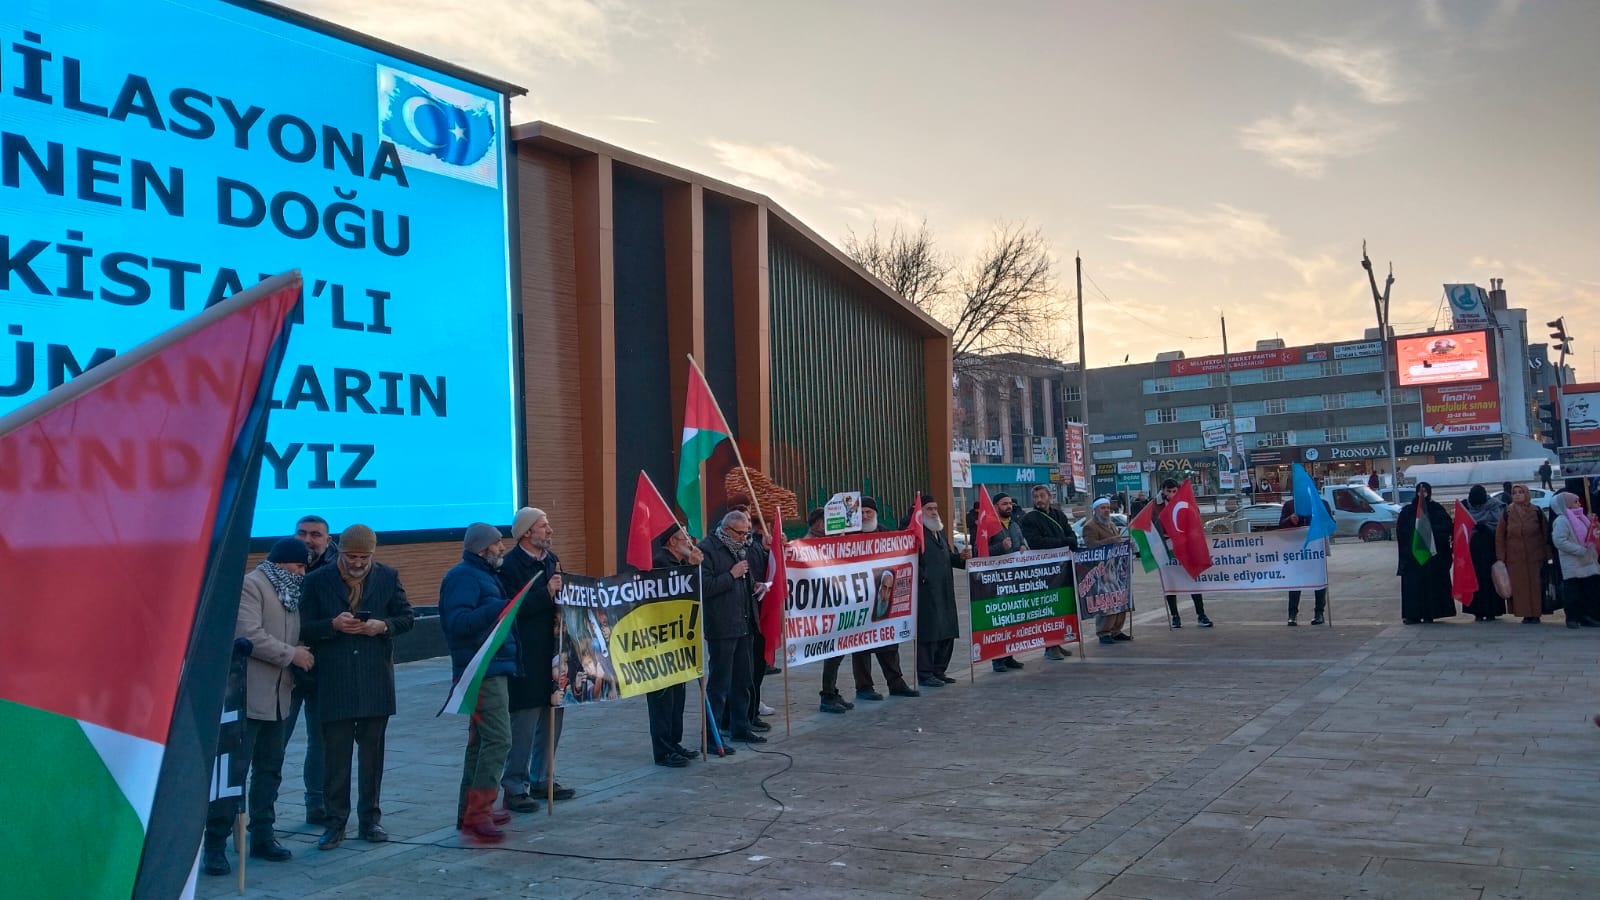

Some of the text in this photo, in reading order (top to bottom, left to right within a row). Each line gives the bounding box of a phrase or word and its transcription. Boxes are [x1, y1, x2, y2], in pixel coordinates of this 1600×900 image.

[216, 176, 411, 257] DOĞU
[1404, 440, 1453, 455] gelinlik
[1158, 459, 1193, 471] ASYA
[837, 540, 874, 558] İNSANLIK
[1212, 536, 1264, 549] Zalimleri
[1255, 548, 1279, 563] ismi
[1283, 548, 1325, 565] şerifine
[1014, 565, 1061, 580] ANLAŞMALAR
[1233, 569, 1286, 583] ediyoruz.
[597, 570, 694, 608] ÖZGÜRLÜK
[785, 575, 849, 611] BOYKOT
[851, 572, 869, 603] ET
[996, 582, 1018, 596] İPTAL
[985, 597, 1030, 614] DİPLOMATİK
[1030, 596, 1040, 607] VE
[821, 614, 836, 634] ET
[837, 610, 857, 632] DUA
[857, 607, 870, 627] ET
[991, 611, 1026, 627] İLİŞKİLER
[983, 630, 1012, 645] İNCİRLİK
[1016, 623, 1042, 638] KÜRECİK
[1042, 618, 1065, 633] ÜSLERİ
[804, 639, 835, 658] DURMA
[837, 629, 879, 651] HAREKETE
[619, 645, 698, 686] DURDURUN
